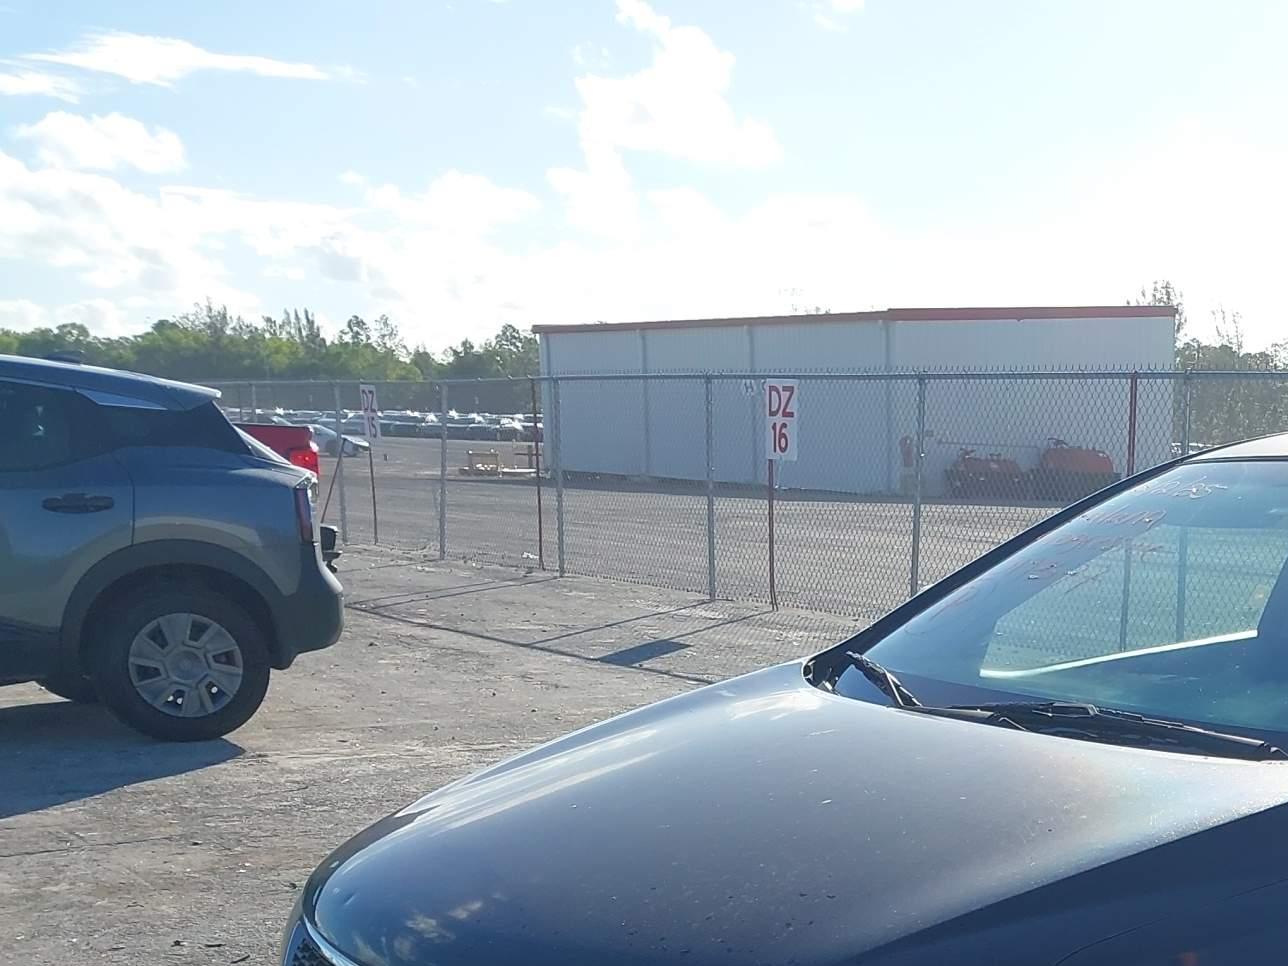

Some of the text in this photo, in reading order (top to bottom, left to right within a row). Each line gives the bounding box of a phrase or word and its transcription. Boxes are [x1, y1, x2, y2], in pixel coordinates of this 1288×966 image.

[361, 389, 377, 413] DZ
[768, 385, 795, 418] DZ
[367, 416, 377, 438] 15
[771, 422, 789, 453] 16
